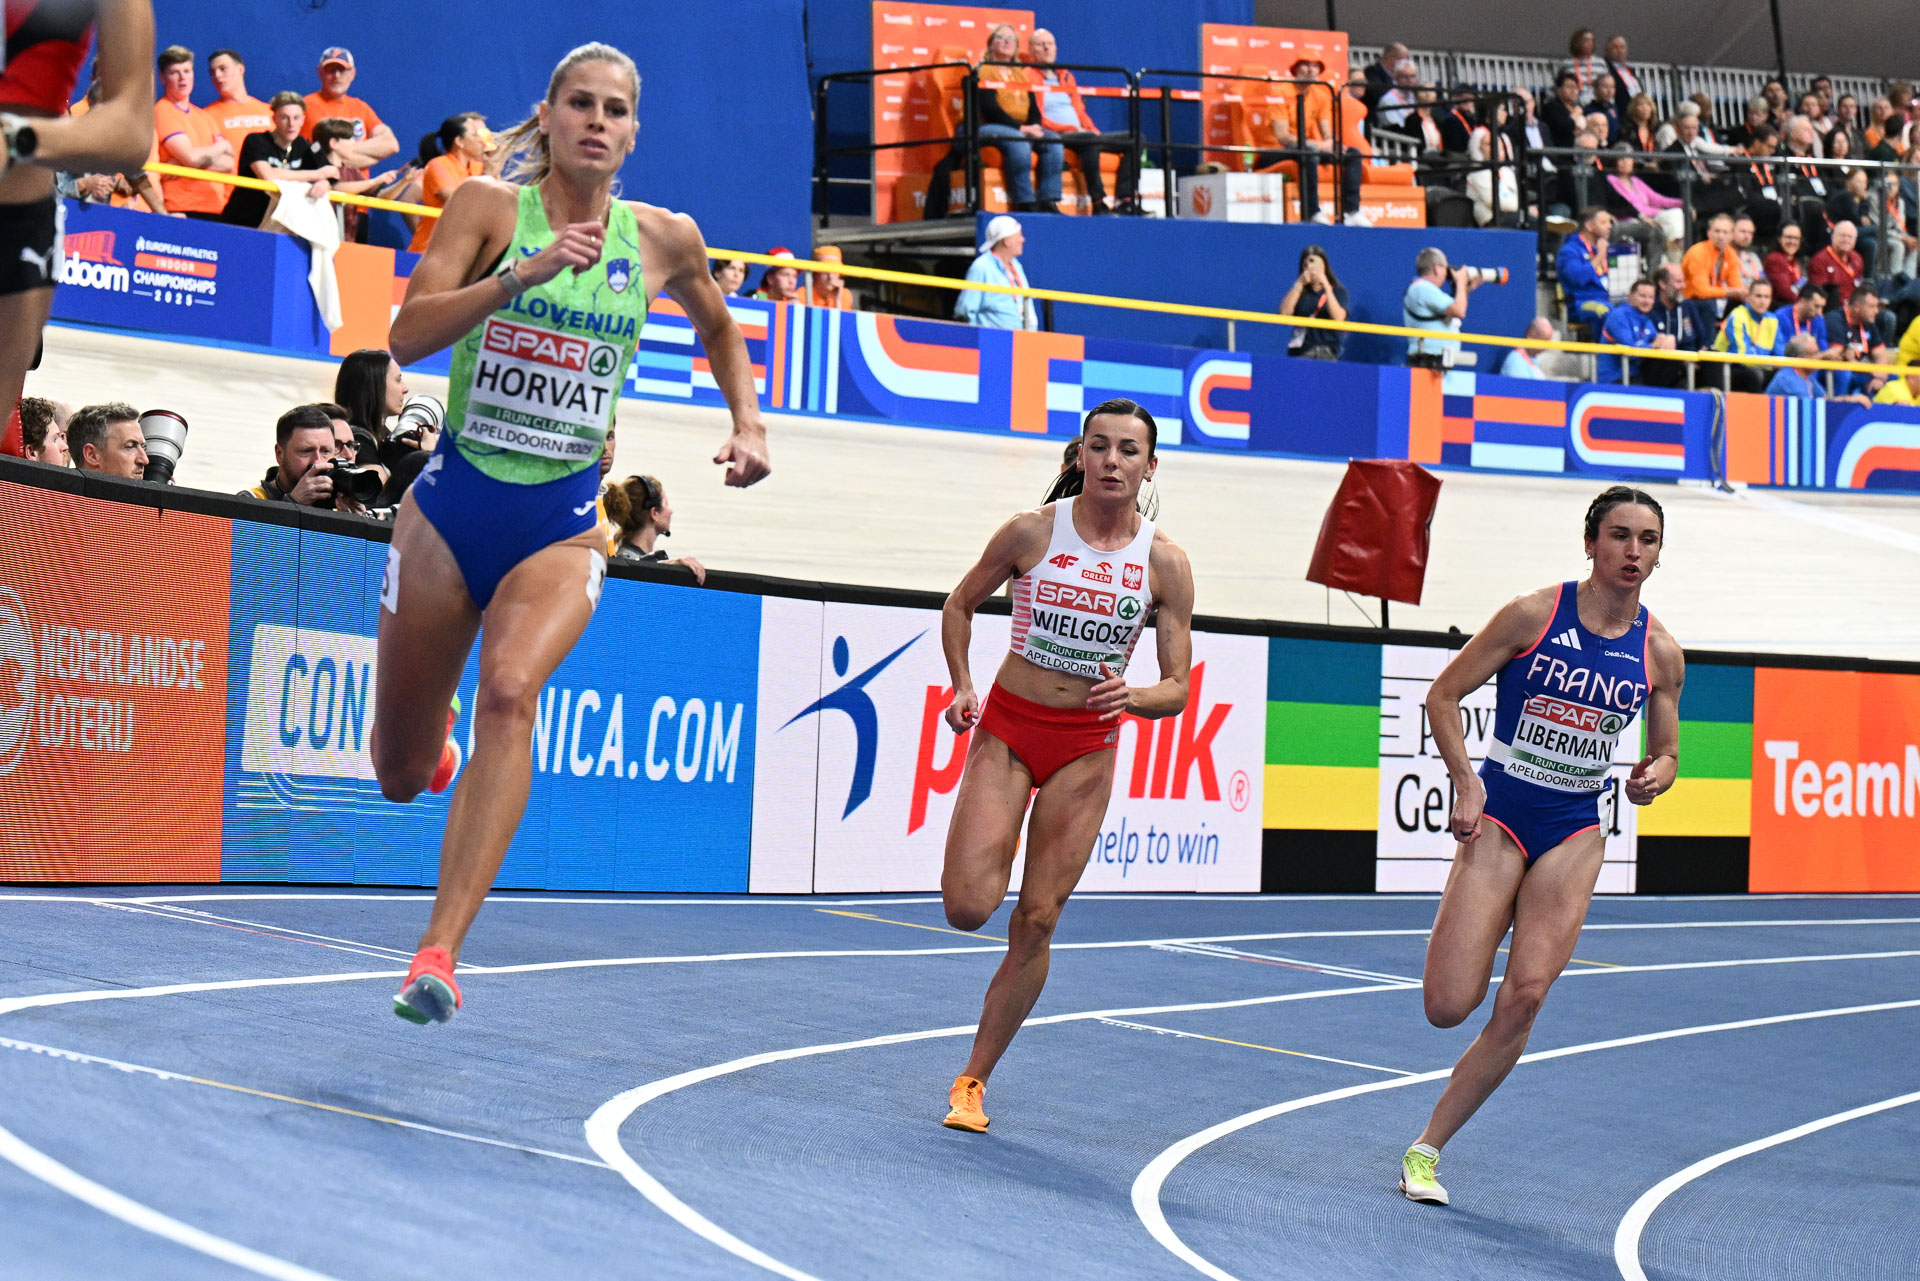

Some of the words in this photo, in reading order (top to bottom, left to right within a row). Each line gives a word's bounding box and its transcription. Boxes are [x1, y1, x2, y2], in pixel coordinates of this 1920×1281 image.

[145, 240, 182, 256] EUROPEAN
[182, 246, 218, 262] ATHLETICS
[155, 257, 196, 273] INDOOR
[133, 270, 217, 295] CHAMPIONSHIPS
[154, 289, 193, 306] 2025
[499, 292, 636, 340] LOVENIJA
[486, 324, 587, 368] SPAR
[475, 359, 609, 415] HORVAT
[501, 411, 532, 427] RUN
[468, 421, 563, 453] APELDOORN
[1048, 553, 1080, 570] 4F
[1082, 571, 1111, 583] ORLEN
[1038, 583, 1114, 613] SPAR
[1032, 608, 1134, 645] WIELGOSZ
[40, 623, 206, 690] NEDERLANDSE
[1026, 650, 1097, 675] APELDOORN
[1050, 643, 1073, 656] RUN
[1526, 652, 1646, 713] FRANCE
[279, 653, 371, 752] CON
[1527, 699, 1600, 729] SPAR
[39, 693, 134, 752] LOTERIJ
[1516, 719, 1613, 763] LIBERMAN
[1508, 762, 1577, 788] APELDOORN
[1577, 779, 1601, 790] 2025
[1535, 757, 1557, 770] RUN
[1147, 824, 1170, 857] to
[1177, 822, 1220, 865] win
